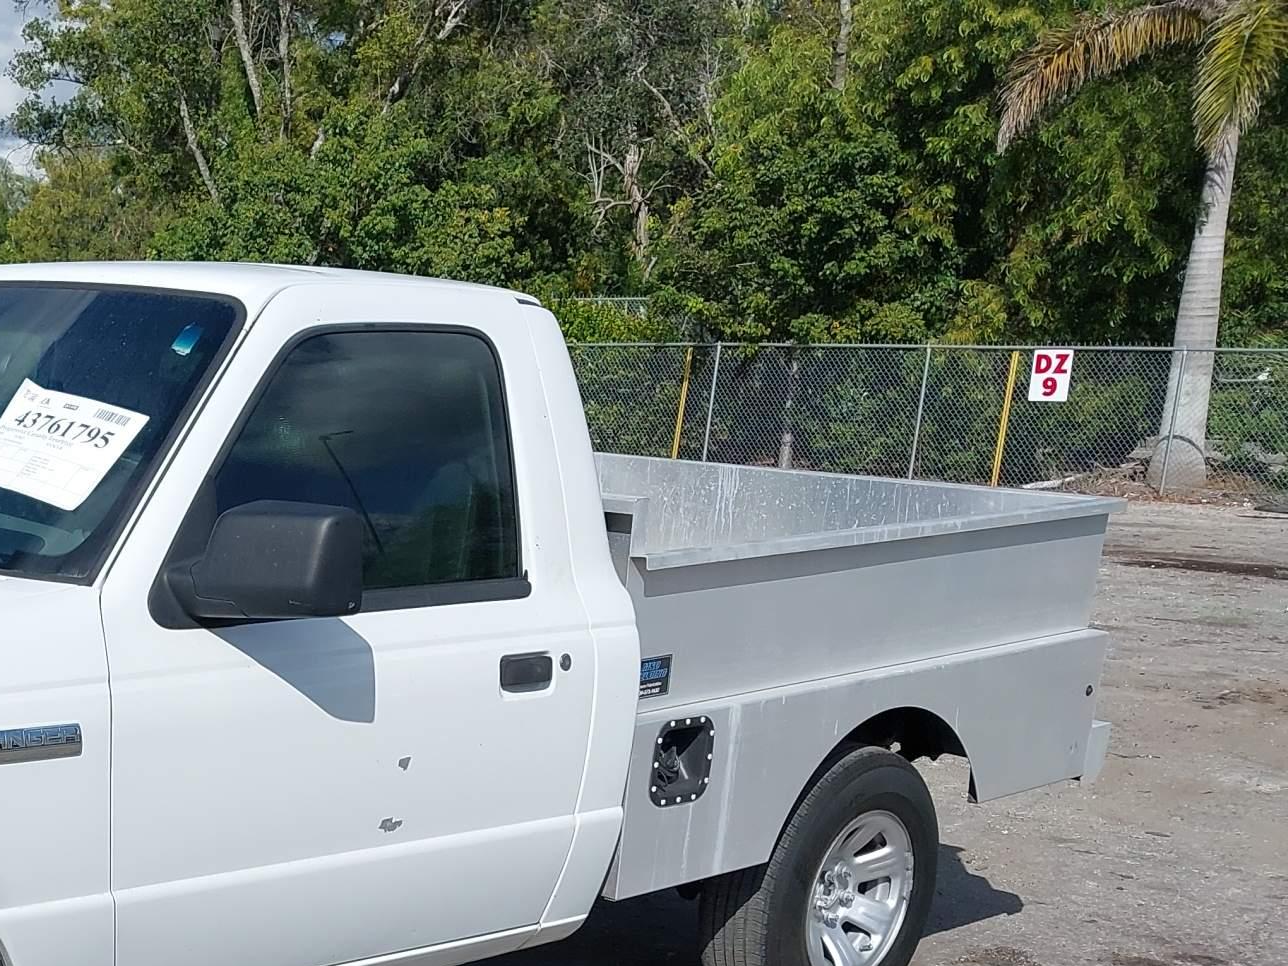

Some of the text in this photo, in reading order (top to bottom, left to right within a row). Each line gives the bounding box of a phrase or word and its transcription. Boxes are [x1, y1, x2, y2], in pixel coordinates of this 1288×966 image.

[1034, 353, 1070, 375] DZ
[1041, 377, 1058, 397] 9
[15, 411, 116, 449] 43761795
